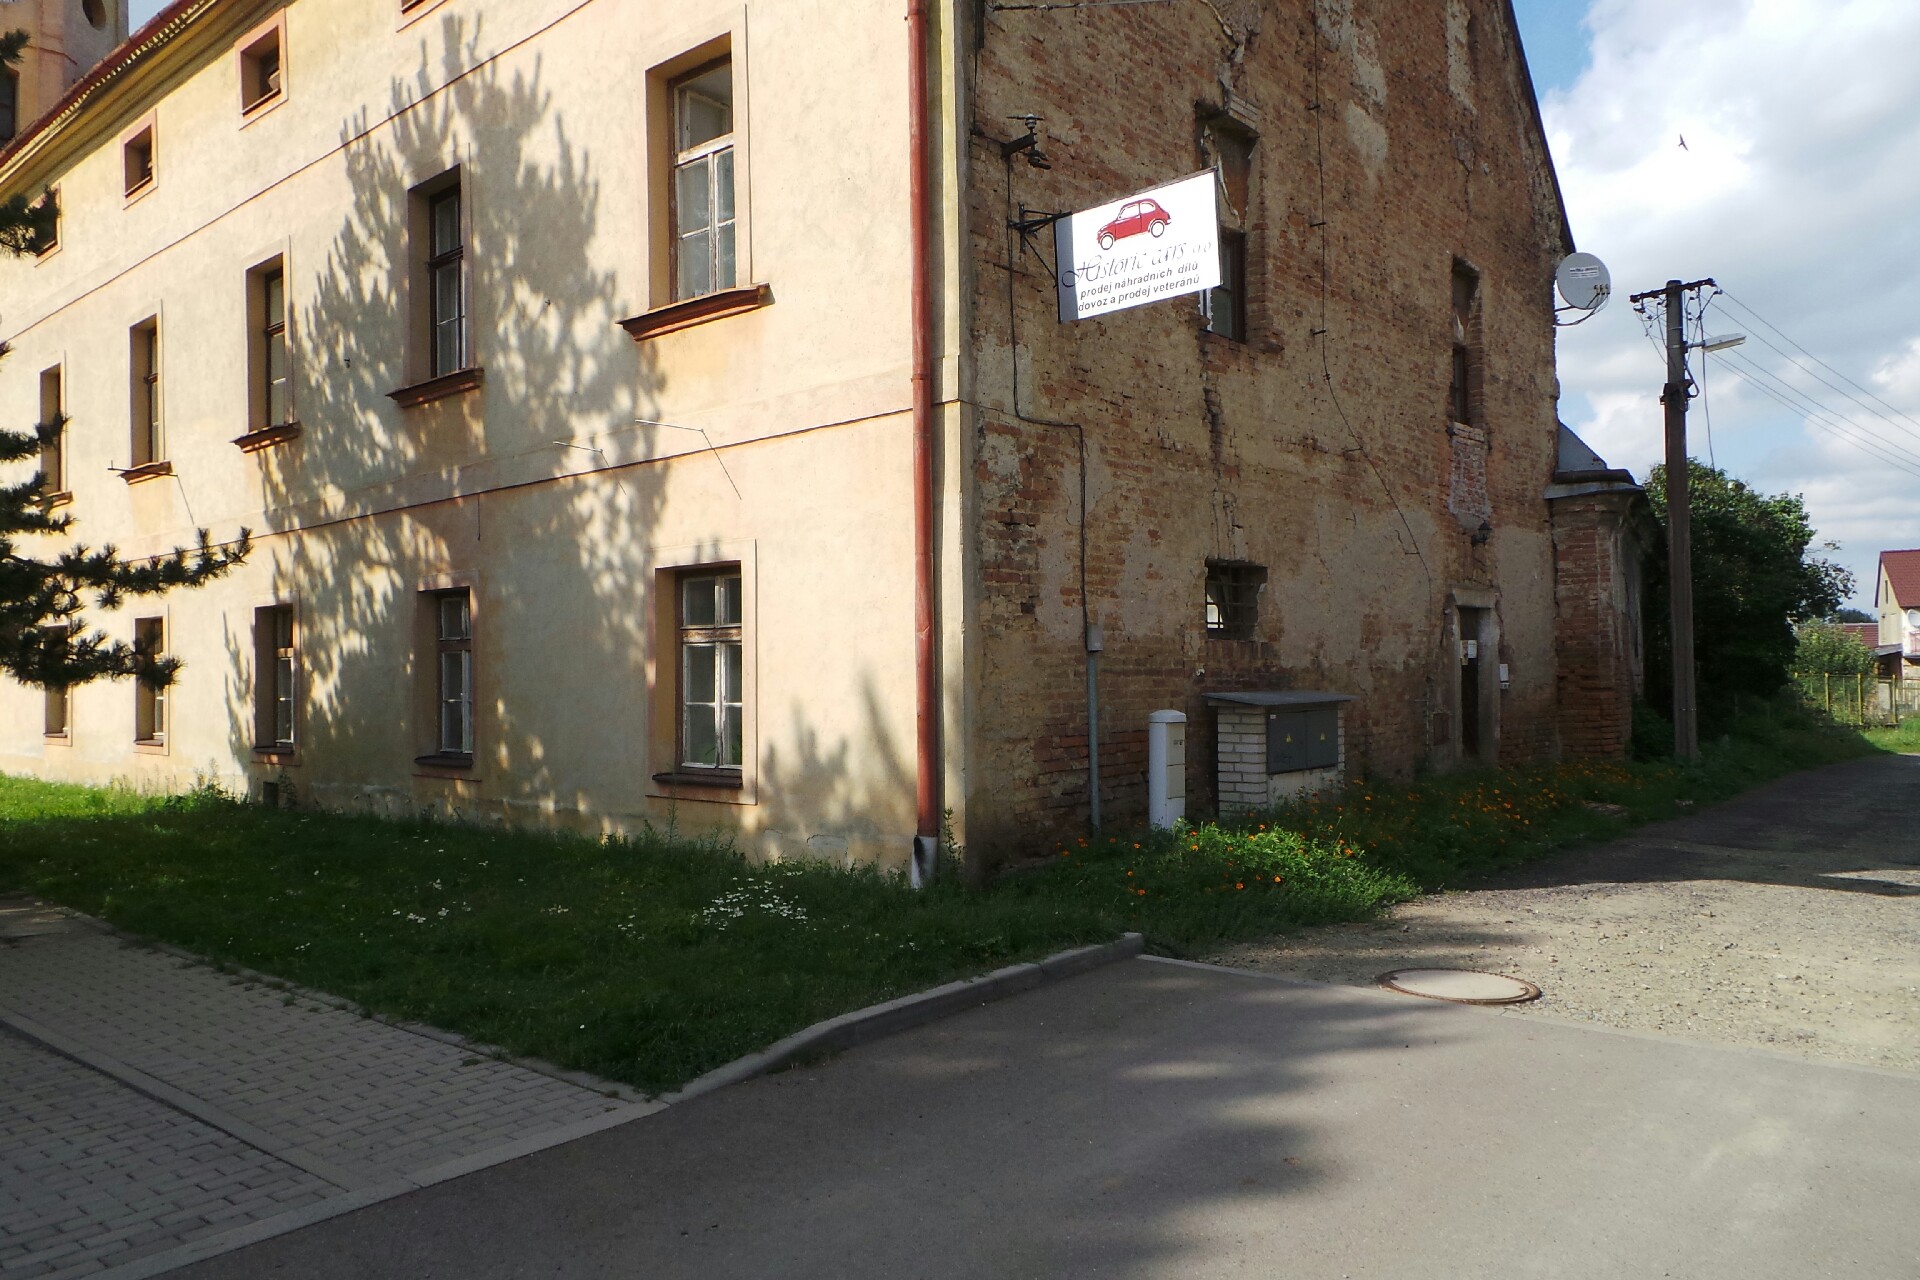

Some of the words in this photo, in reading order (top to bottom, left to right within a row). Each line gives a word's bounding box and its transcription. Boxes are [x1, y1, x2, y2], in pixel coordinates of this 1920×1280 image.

[1061, 254, 1147, 288] Historic
[1080, 282, 1112, 300] prodej
[1115, 268, 1173, 290] náhradních
[1078, 299, 1108, 312] dovoz
[1110, 296, 1117, 304] a
[1118, 286, 1151, 304] prodej
